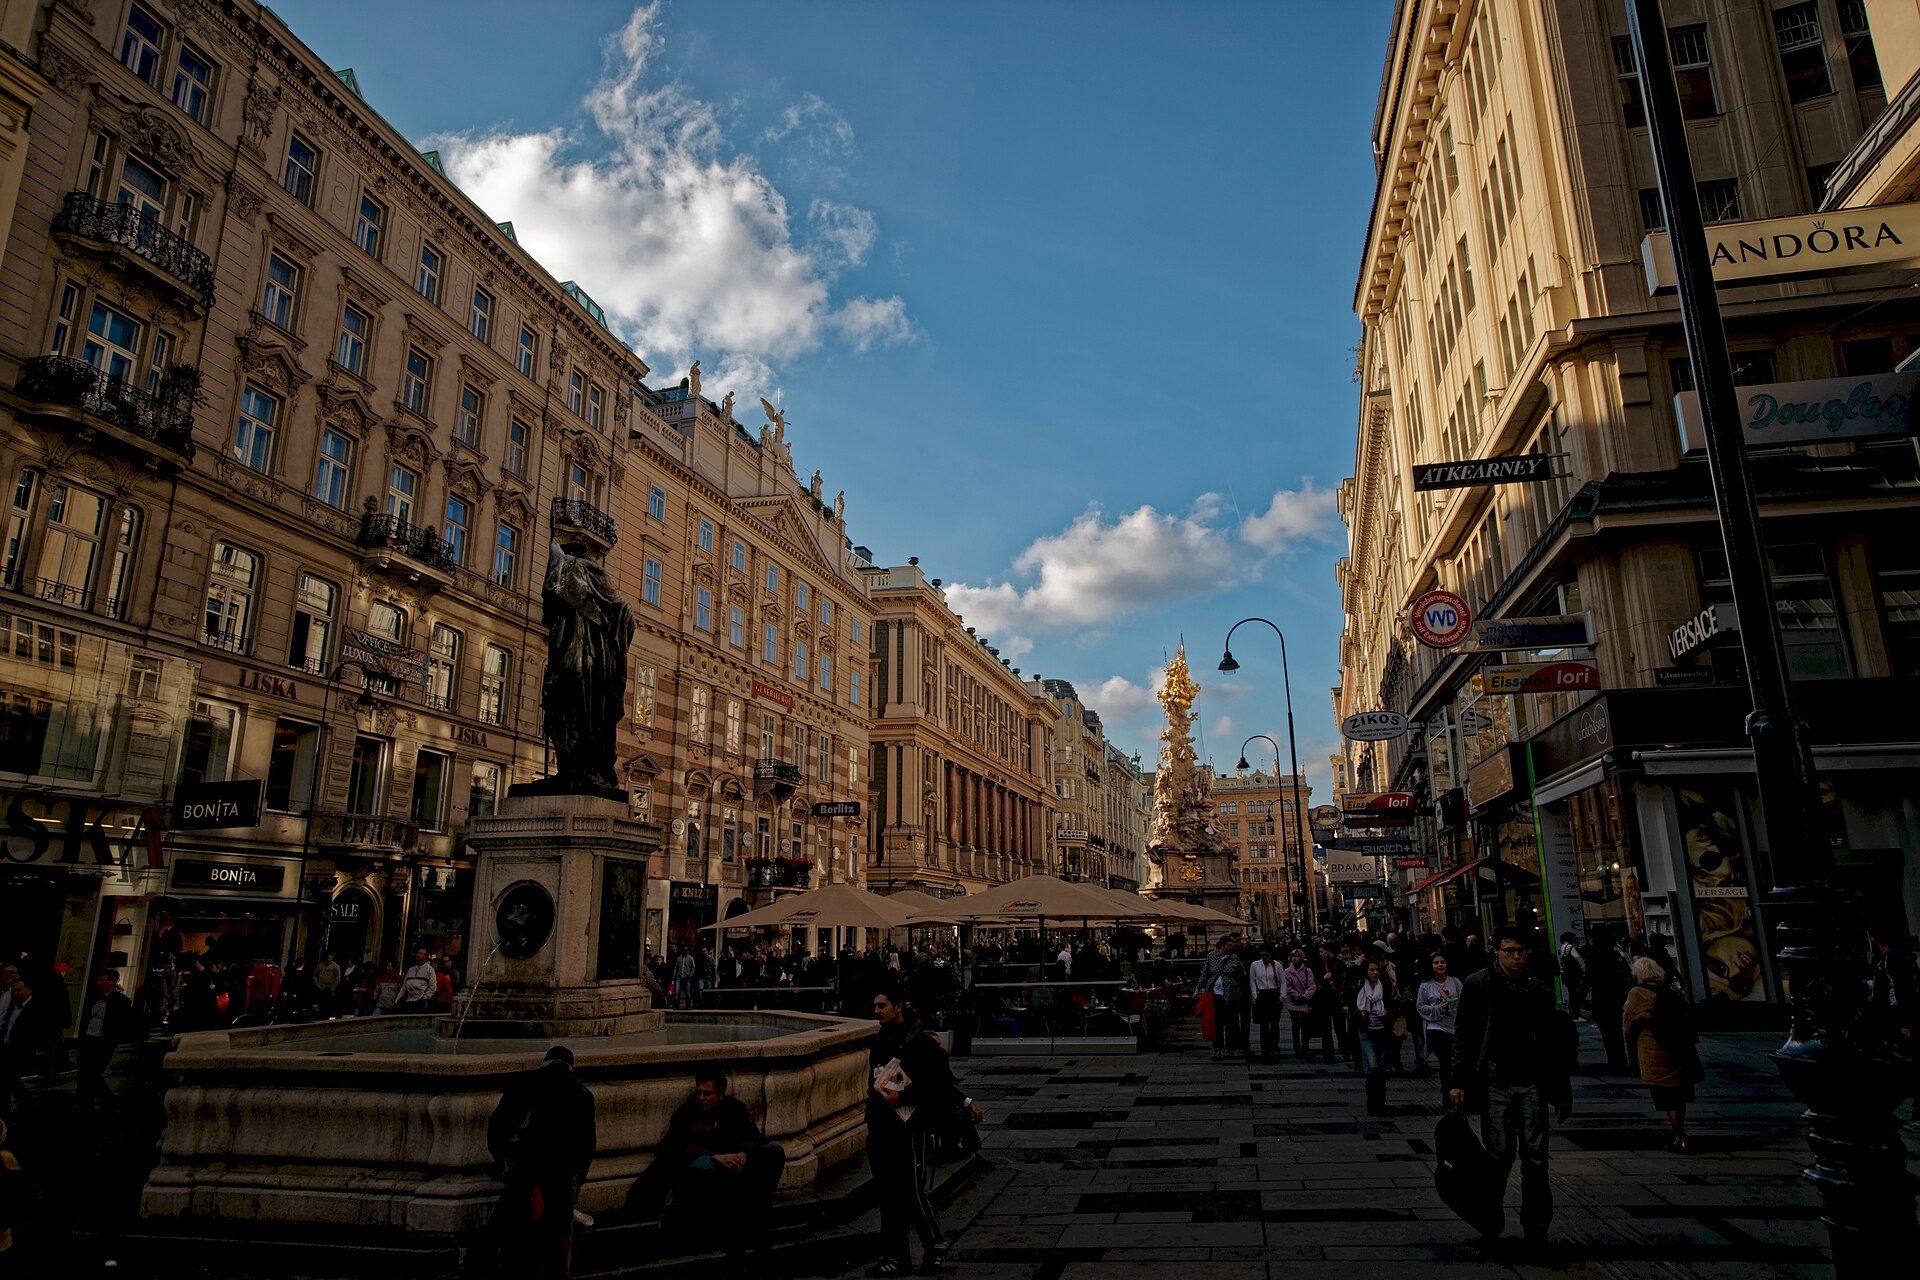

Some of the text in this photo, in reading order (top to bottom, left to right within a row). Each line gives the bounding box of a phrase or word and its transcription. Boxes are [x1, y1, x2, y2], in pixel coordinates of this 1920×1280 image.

[1712, 221, 1903, 266] ANDORA
[1426, 610, 1456, 627] VVD
[1667, 605, 1719, 659] VERSACE
[342, 645, 374, 664] LUXUS
[238, 668, 297, 700] LISKA
[1491, 676, 1552, 688] Eissalon
[1349, 714, 1400, 729] ZIKOS
[450, 724, 487, 748] LISKA
[820, 804, 855, 814] Berlitz
[1347, 801, 1385, 809] Eissalon
[1331, 862, 1372, 873] BRAMO
[1697, 888, 1745, 896] VERSACE
[331, 903, 359, 917] SALE
